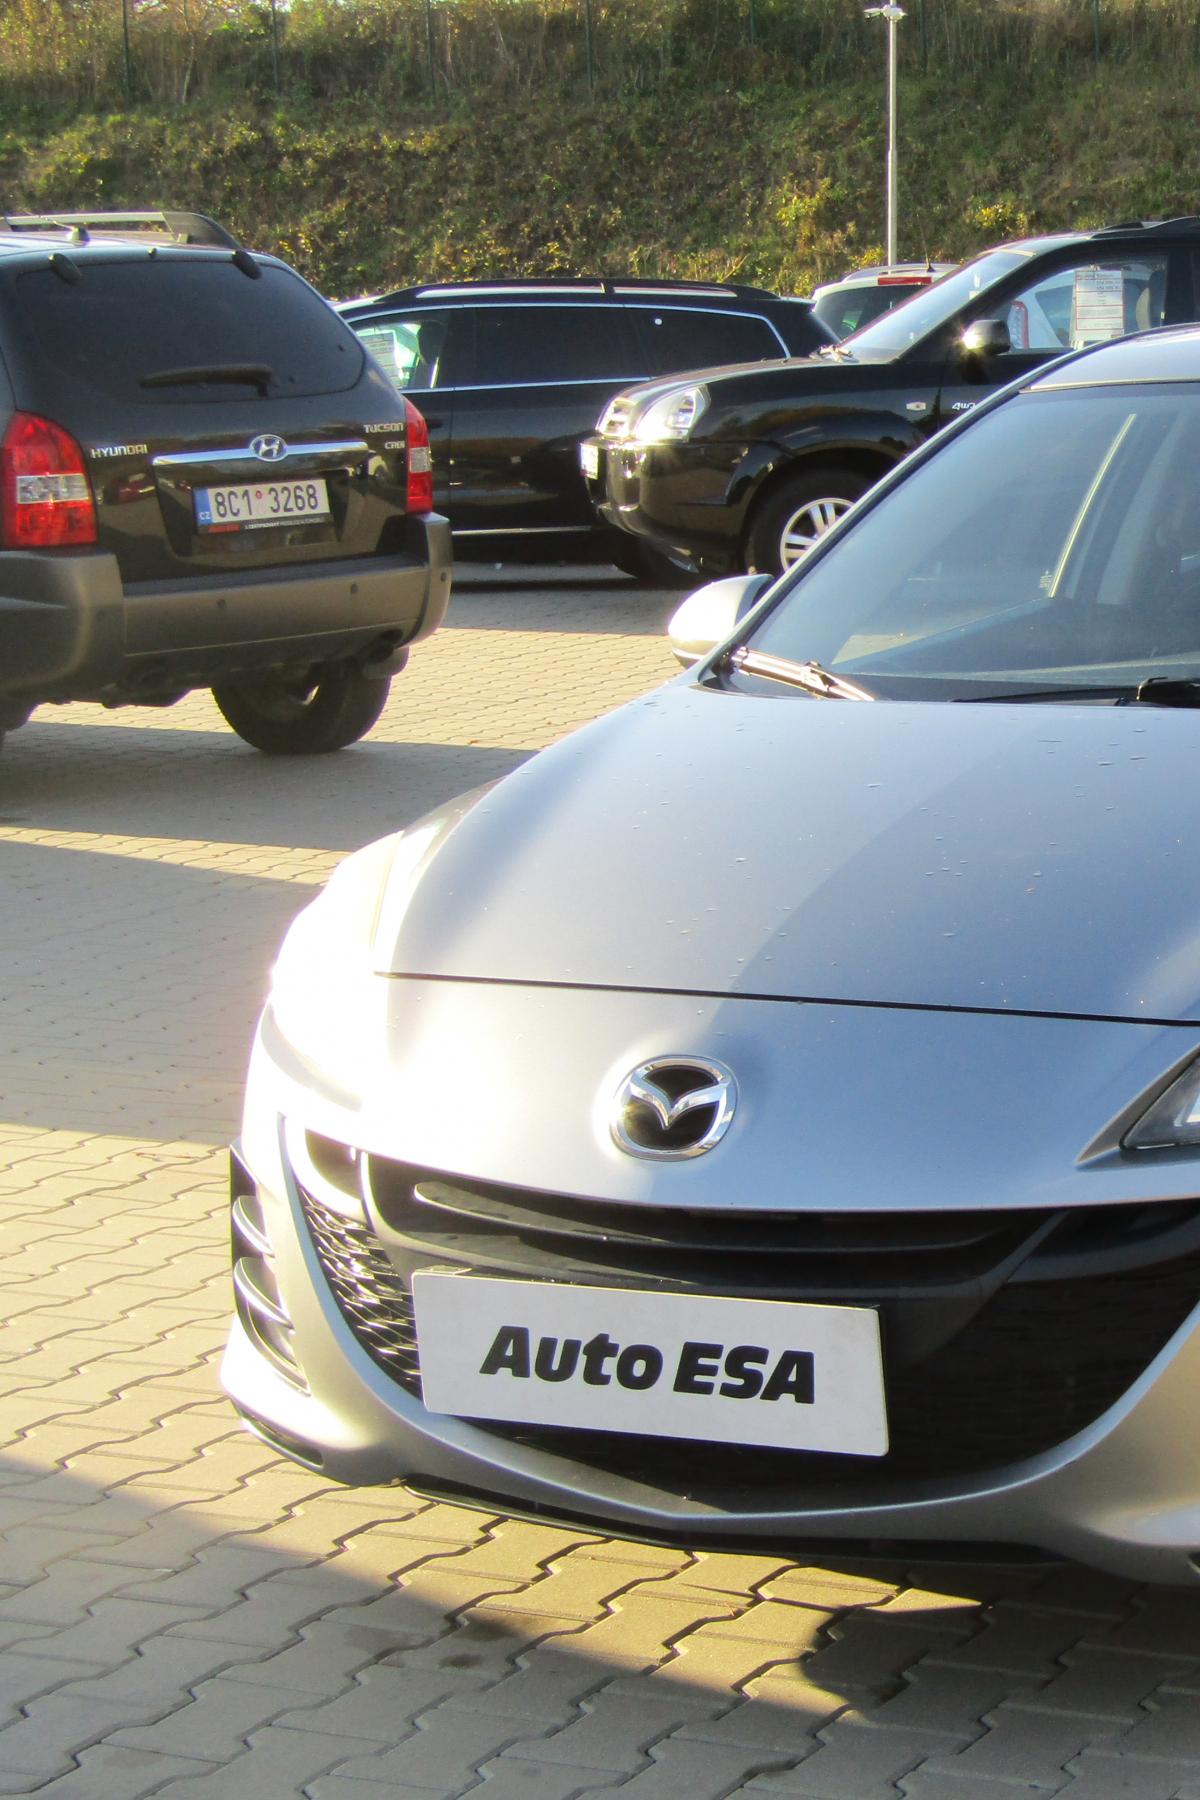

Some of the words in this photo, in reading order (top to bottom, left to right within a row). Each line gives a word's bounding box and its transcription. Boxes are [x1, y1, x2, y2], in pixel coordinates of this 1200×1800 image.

[363, 422, 404, 433] TUCSON
[90, 444, 149, 459] HYUNDAI
[214, 488, 253, 518] 8C1
[267, 483, 319, 513] 3268
[478, 1325, 664, 1391] Auto
[672, 1340, 816, 1405] ESA
